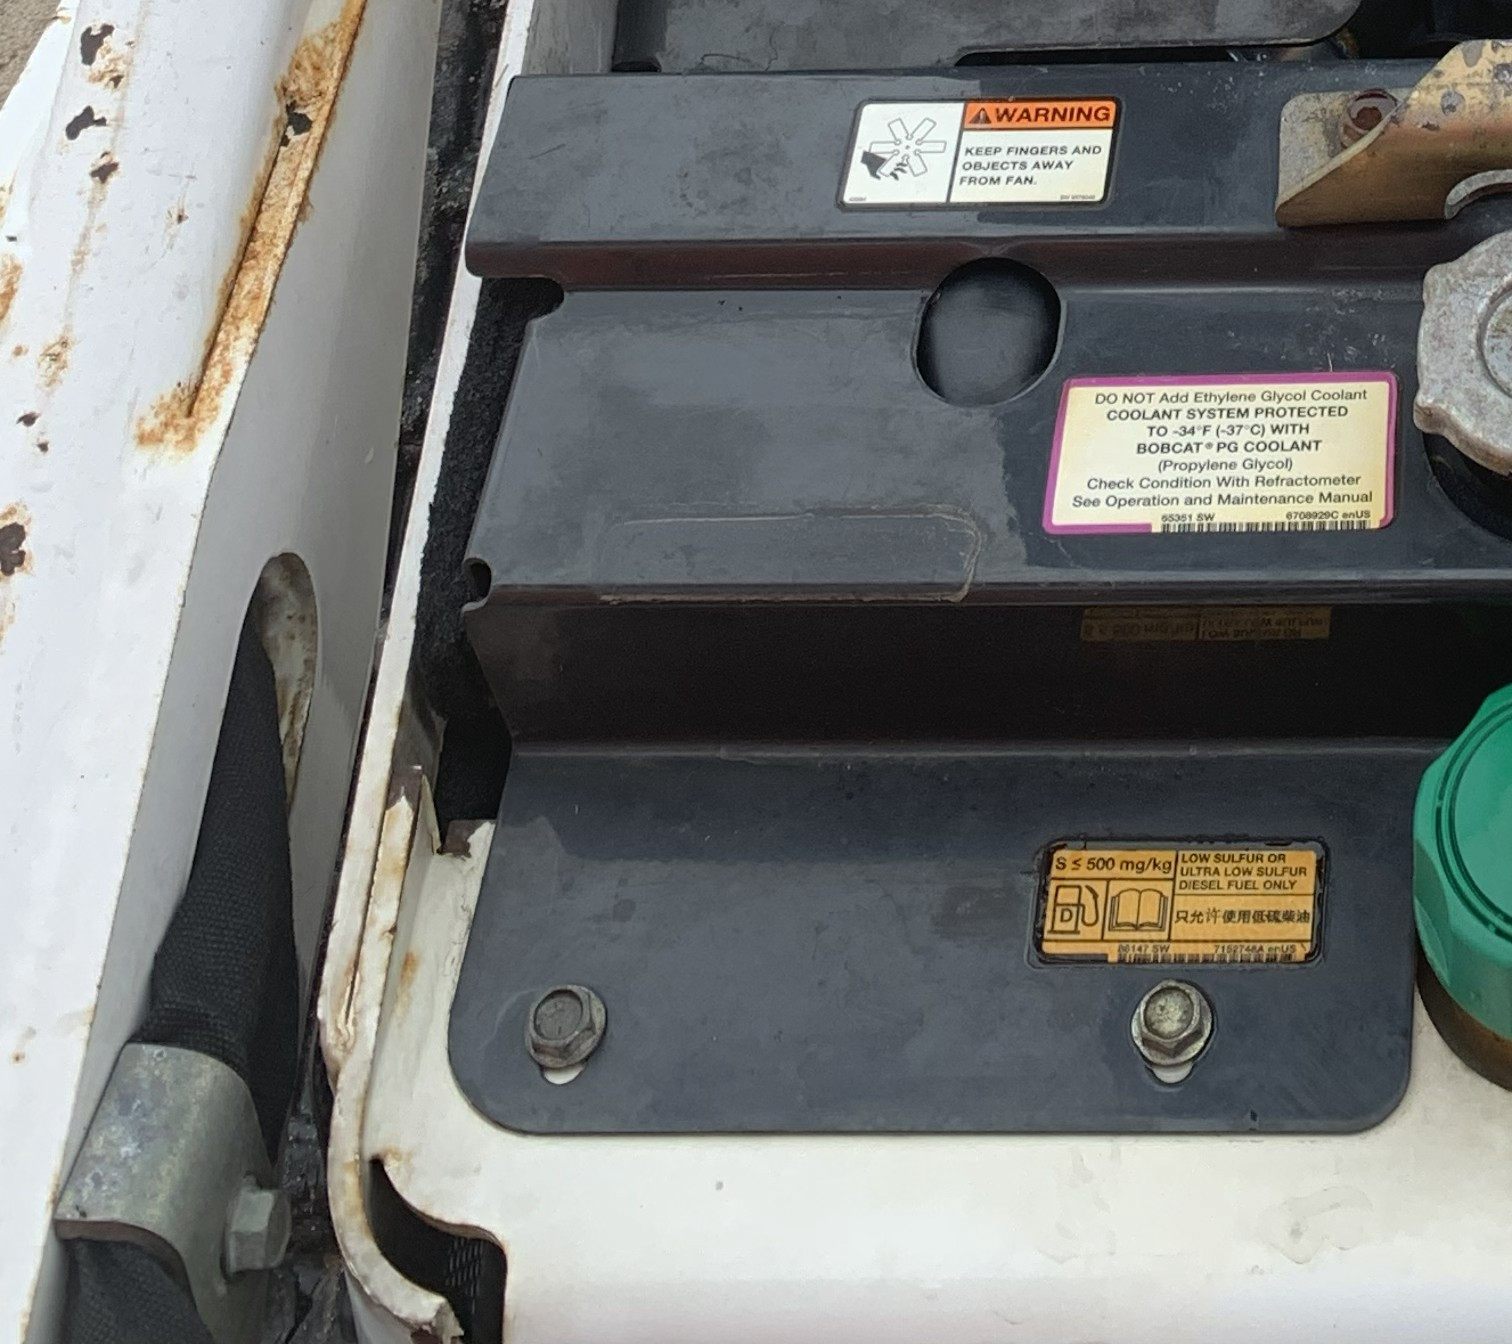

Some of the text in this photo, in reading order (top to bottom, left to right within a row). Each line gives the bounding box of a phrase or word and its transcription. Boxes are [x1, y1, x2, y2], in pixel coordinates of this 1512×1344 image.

[994, 105, 1111, 123] WARNING
[965, 144, 1102, 156] KEEP FINGERS AND
[962, 160, 1074, 171] OBJECTS AWAY
[959, 175, 1037, 186] FROM FAN.
[1095, 389, 1368, 406] DO NOT Add Ethylene Glycol Coolant
[1106, 406, 1349, 421] COOLANT SYSTEM PROTECTED
[1148, 425, 1168, 437] TO
[1270, 423, 1310, 435] WITH
[1216, 441, 1238, 454] PG
[1243, 440, 1322, 453] COOLANT
[1158, 457, 1293, 475] (Propylene Glycol)
[1087, 474, 1361, 490] Check Condition With Refractometer
[1072, 490, 1373, 510] See Operation and Maintenance Manual
[1197, 513, 1215, 522] SW
[1342, 510, 1371, 520] enUS
[1055, 857, 1067, 871] S
[1086, 857, 1115, 871] 500
[1119, 857, 1173, 874] mg/kg
[1181, 853, 1287, 864] LOW SULFUR OR
[1180, 866, 1308, 877] ULTRA LOW SULFUR
[1179, 879, 1298, 891] DIESEL FUEL ONLY
[1151, 944, 1171, 954] SW
